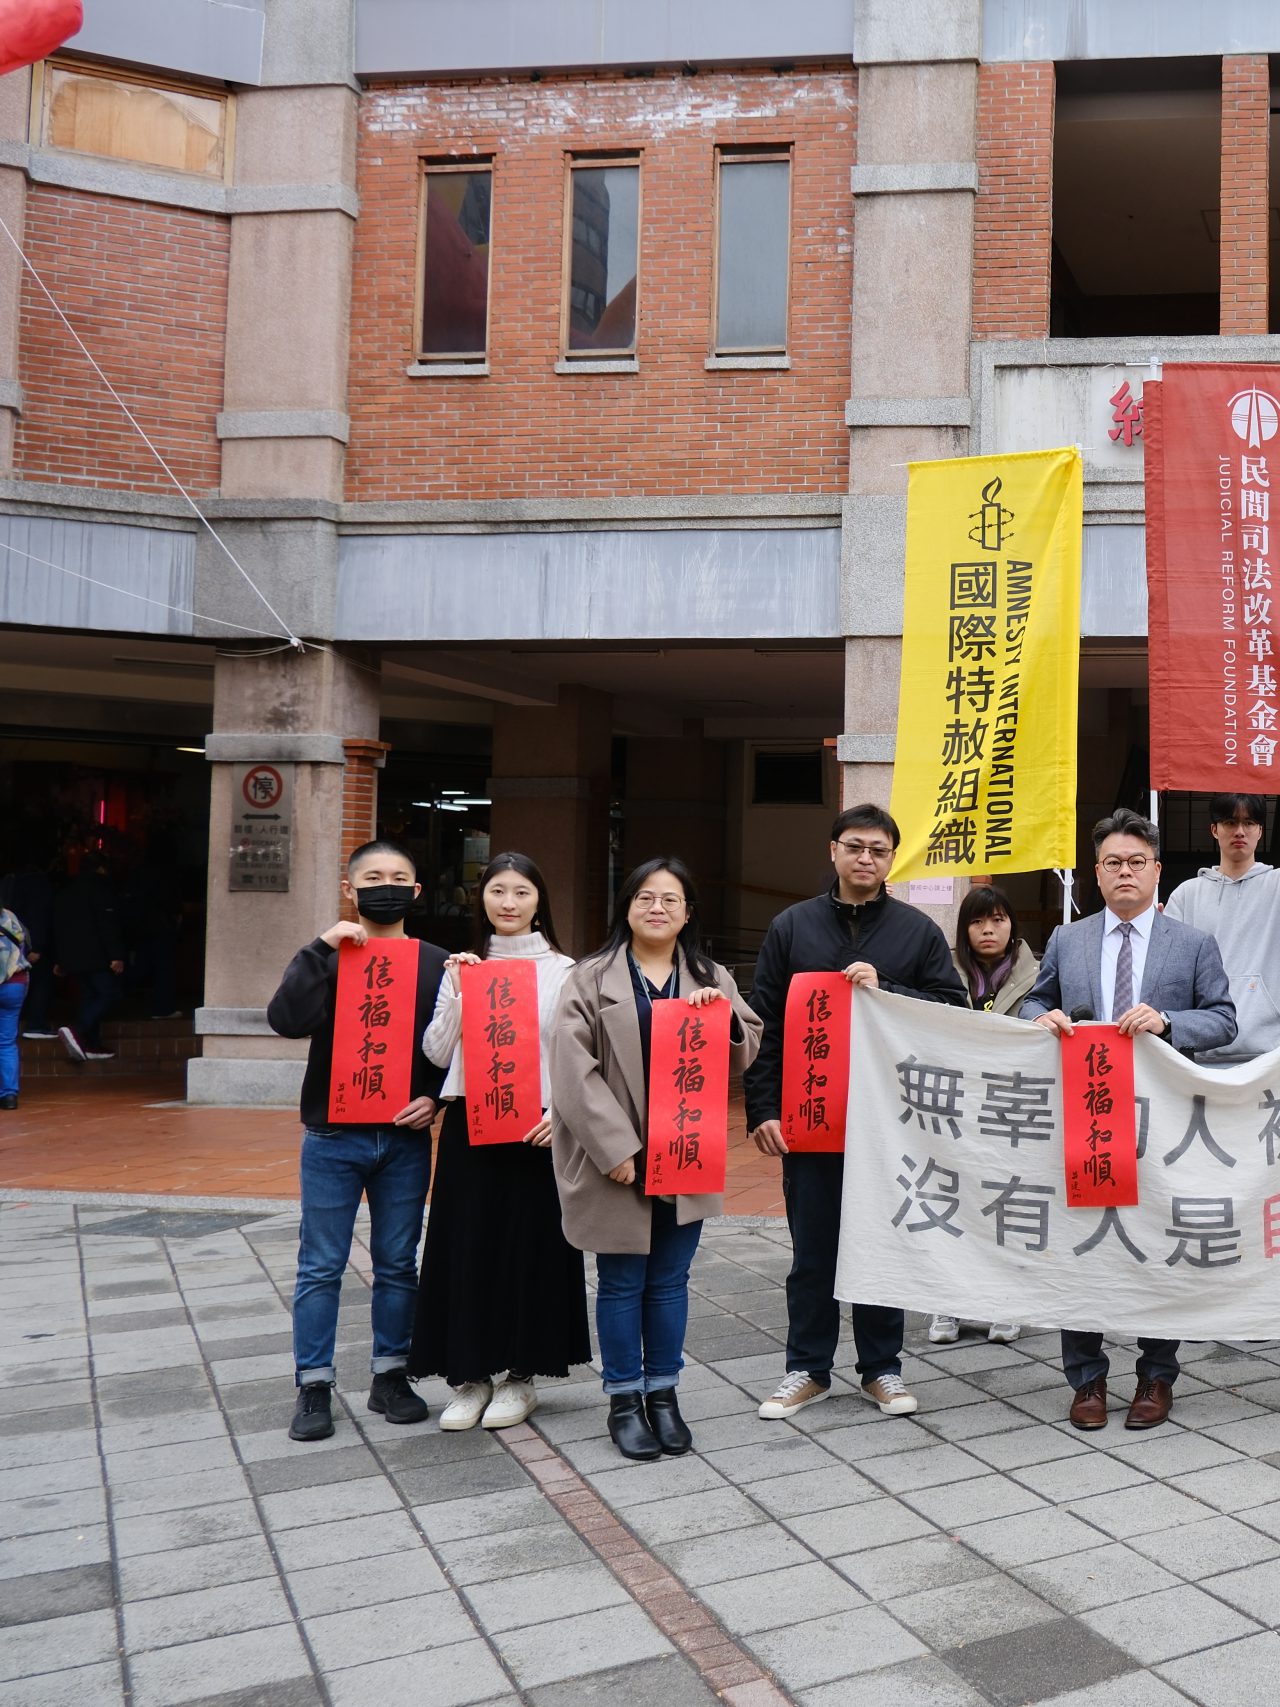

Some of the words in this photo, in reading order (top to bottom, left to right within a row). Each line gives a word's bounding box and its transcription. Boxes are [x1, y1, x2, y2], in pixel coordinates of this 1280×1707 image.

[1218, 454, 1233, 542] JUDICIAL
[1004, 559, 1033, 666] AMNESTY
[1222, 551, 1235, 630] REFORM
[1240, 454, 1279, 767] 民間司法改革基金會
[925, 561, 998, 867] 國際特赦組織
[984, 673, 1019, 864] INTERNATIONAL
[1223, 639, 1238, 765] FOUNDATION
[253, 776, 274, 800] 停
[352, 956, 394, 1100] 信福和順
[484, 977, 519, 1120] 信福和順
[669, 1017, 706, 1170] 信福和順
[799, 989, 832, 1132] 信福和順
[1082, 1043, 1117, 1187] 信福和順
